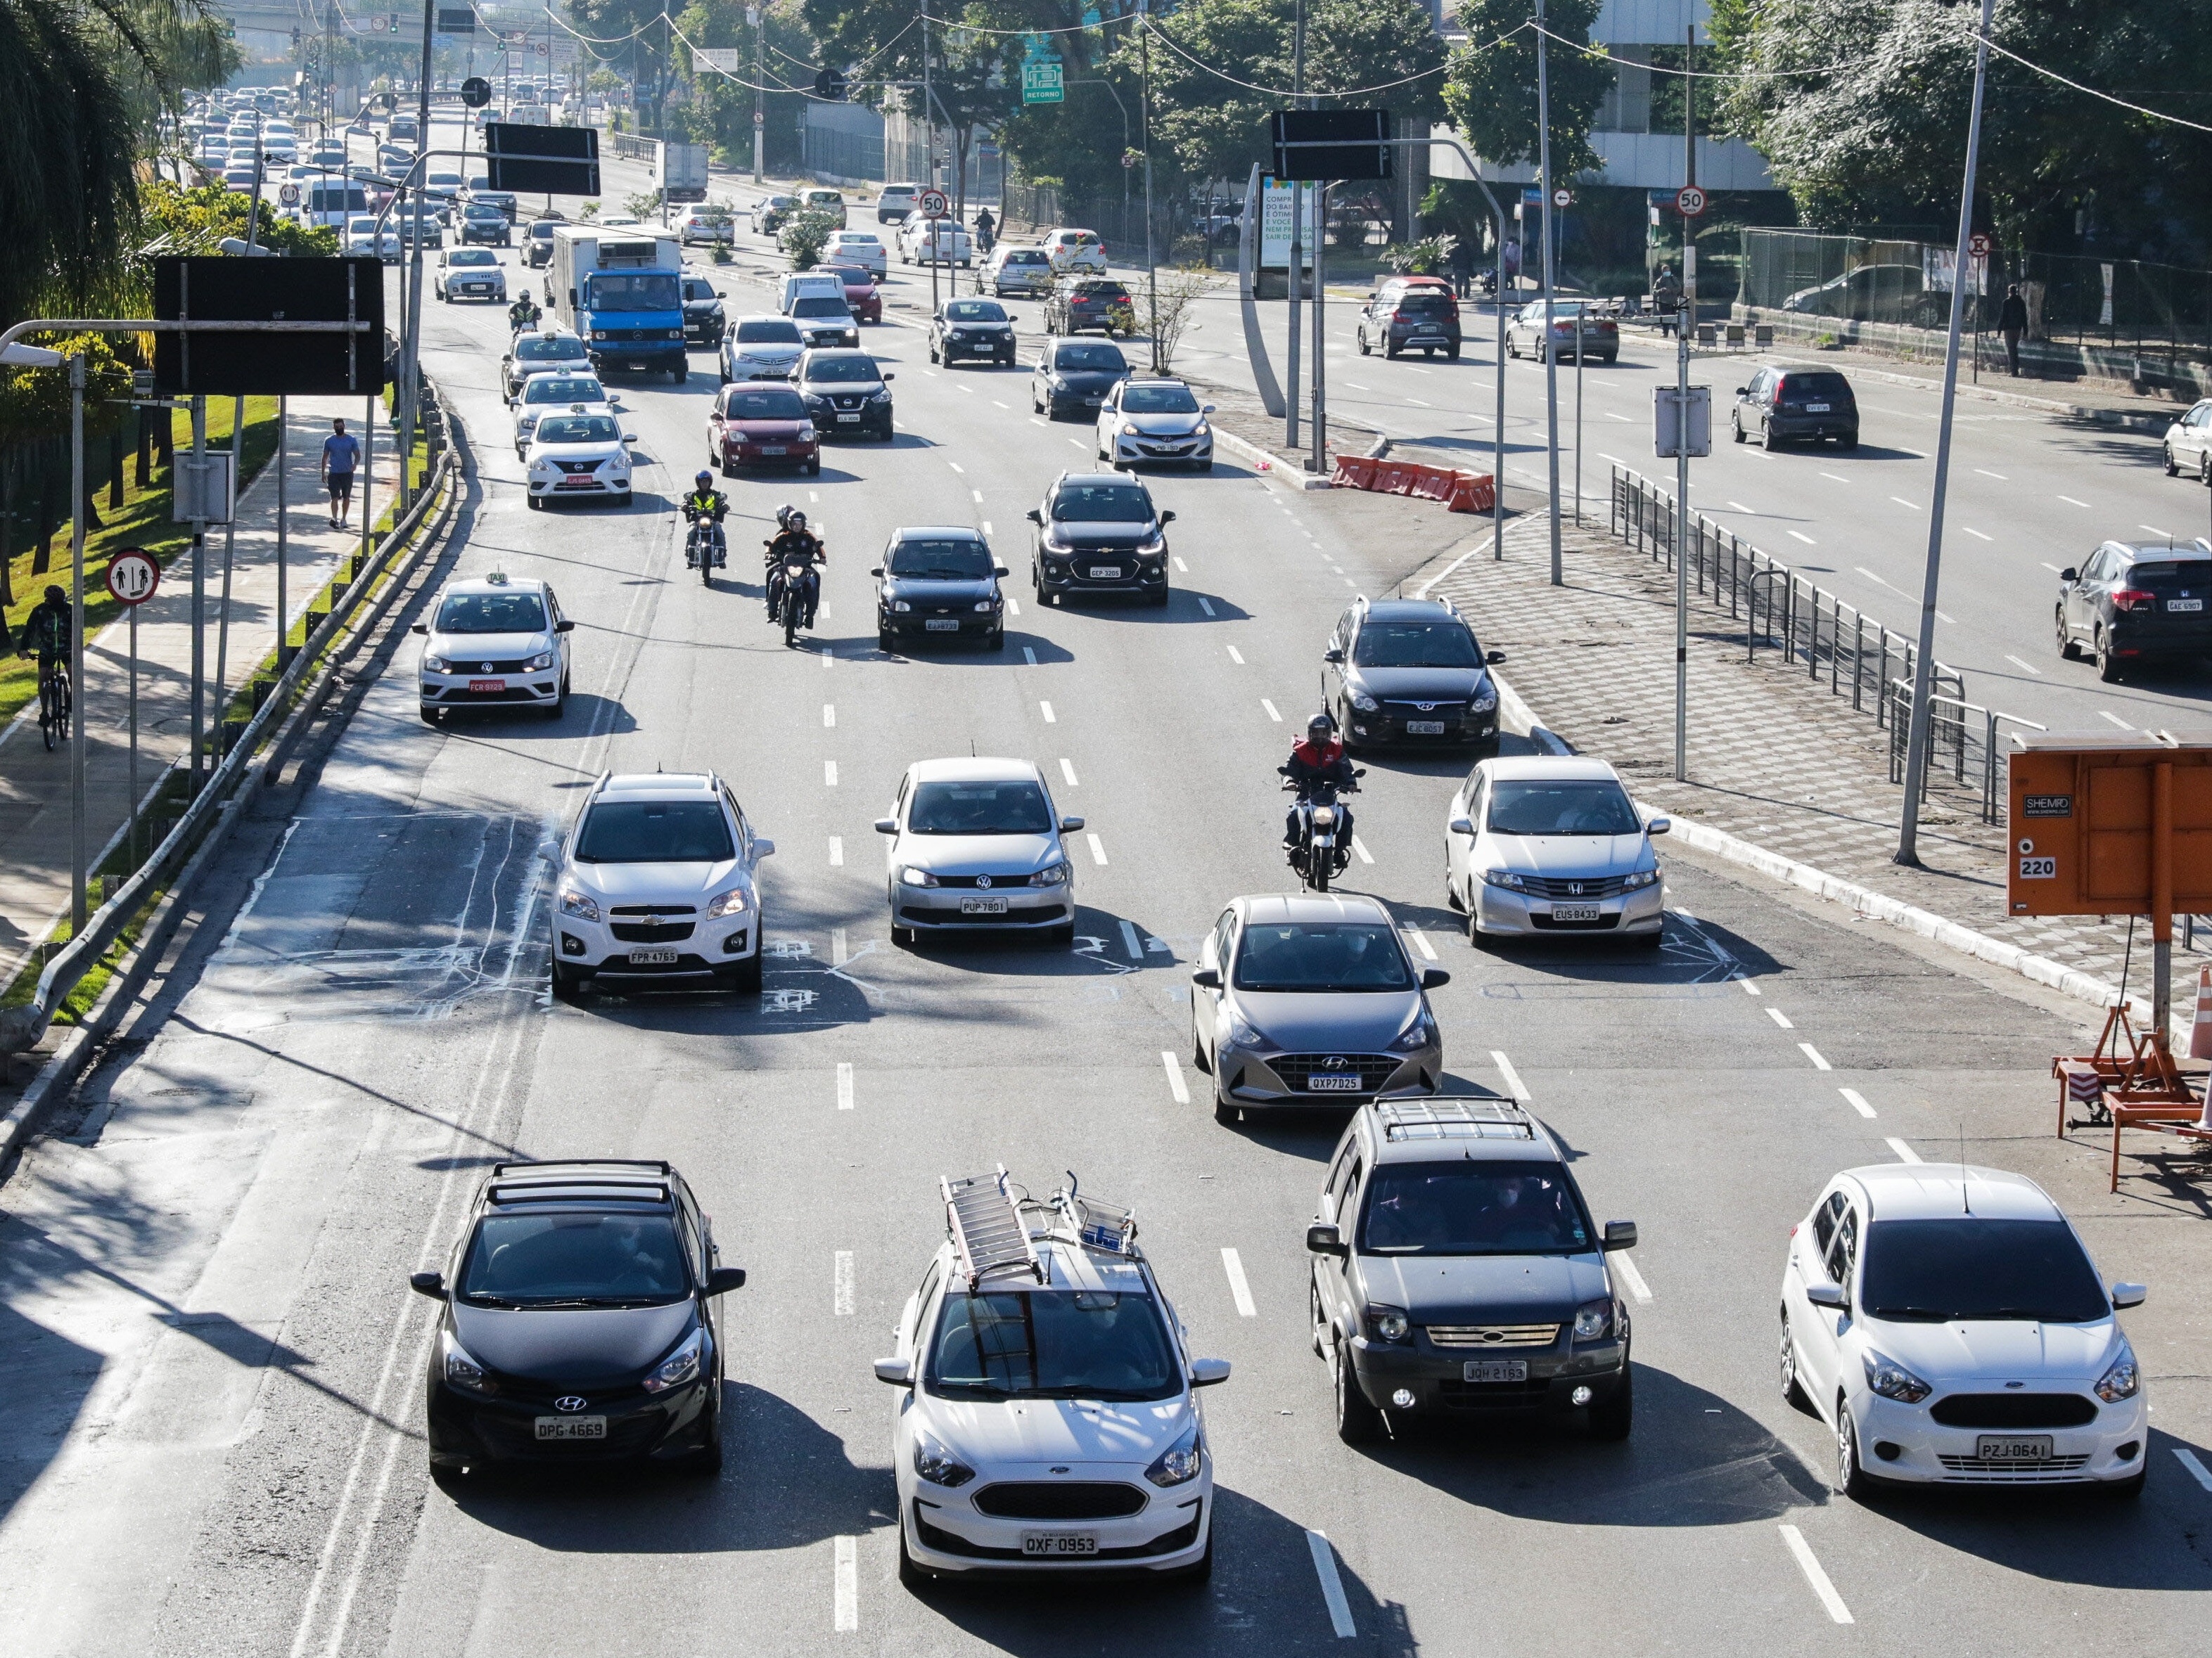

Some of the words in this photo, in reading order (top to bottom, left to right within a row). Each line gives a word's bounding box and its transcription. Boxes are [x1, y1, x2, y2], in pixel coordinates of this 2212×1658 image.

[925, 198, 942, 210] 50
[1682, 193, 1701, 207] 50
[2021, 861, 2054, 875] 220
[1313, 1079, 1357, 1088] QXP7D25
